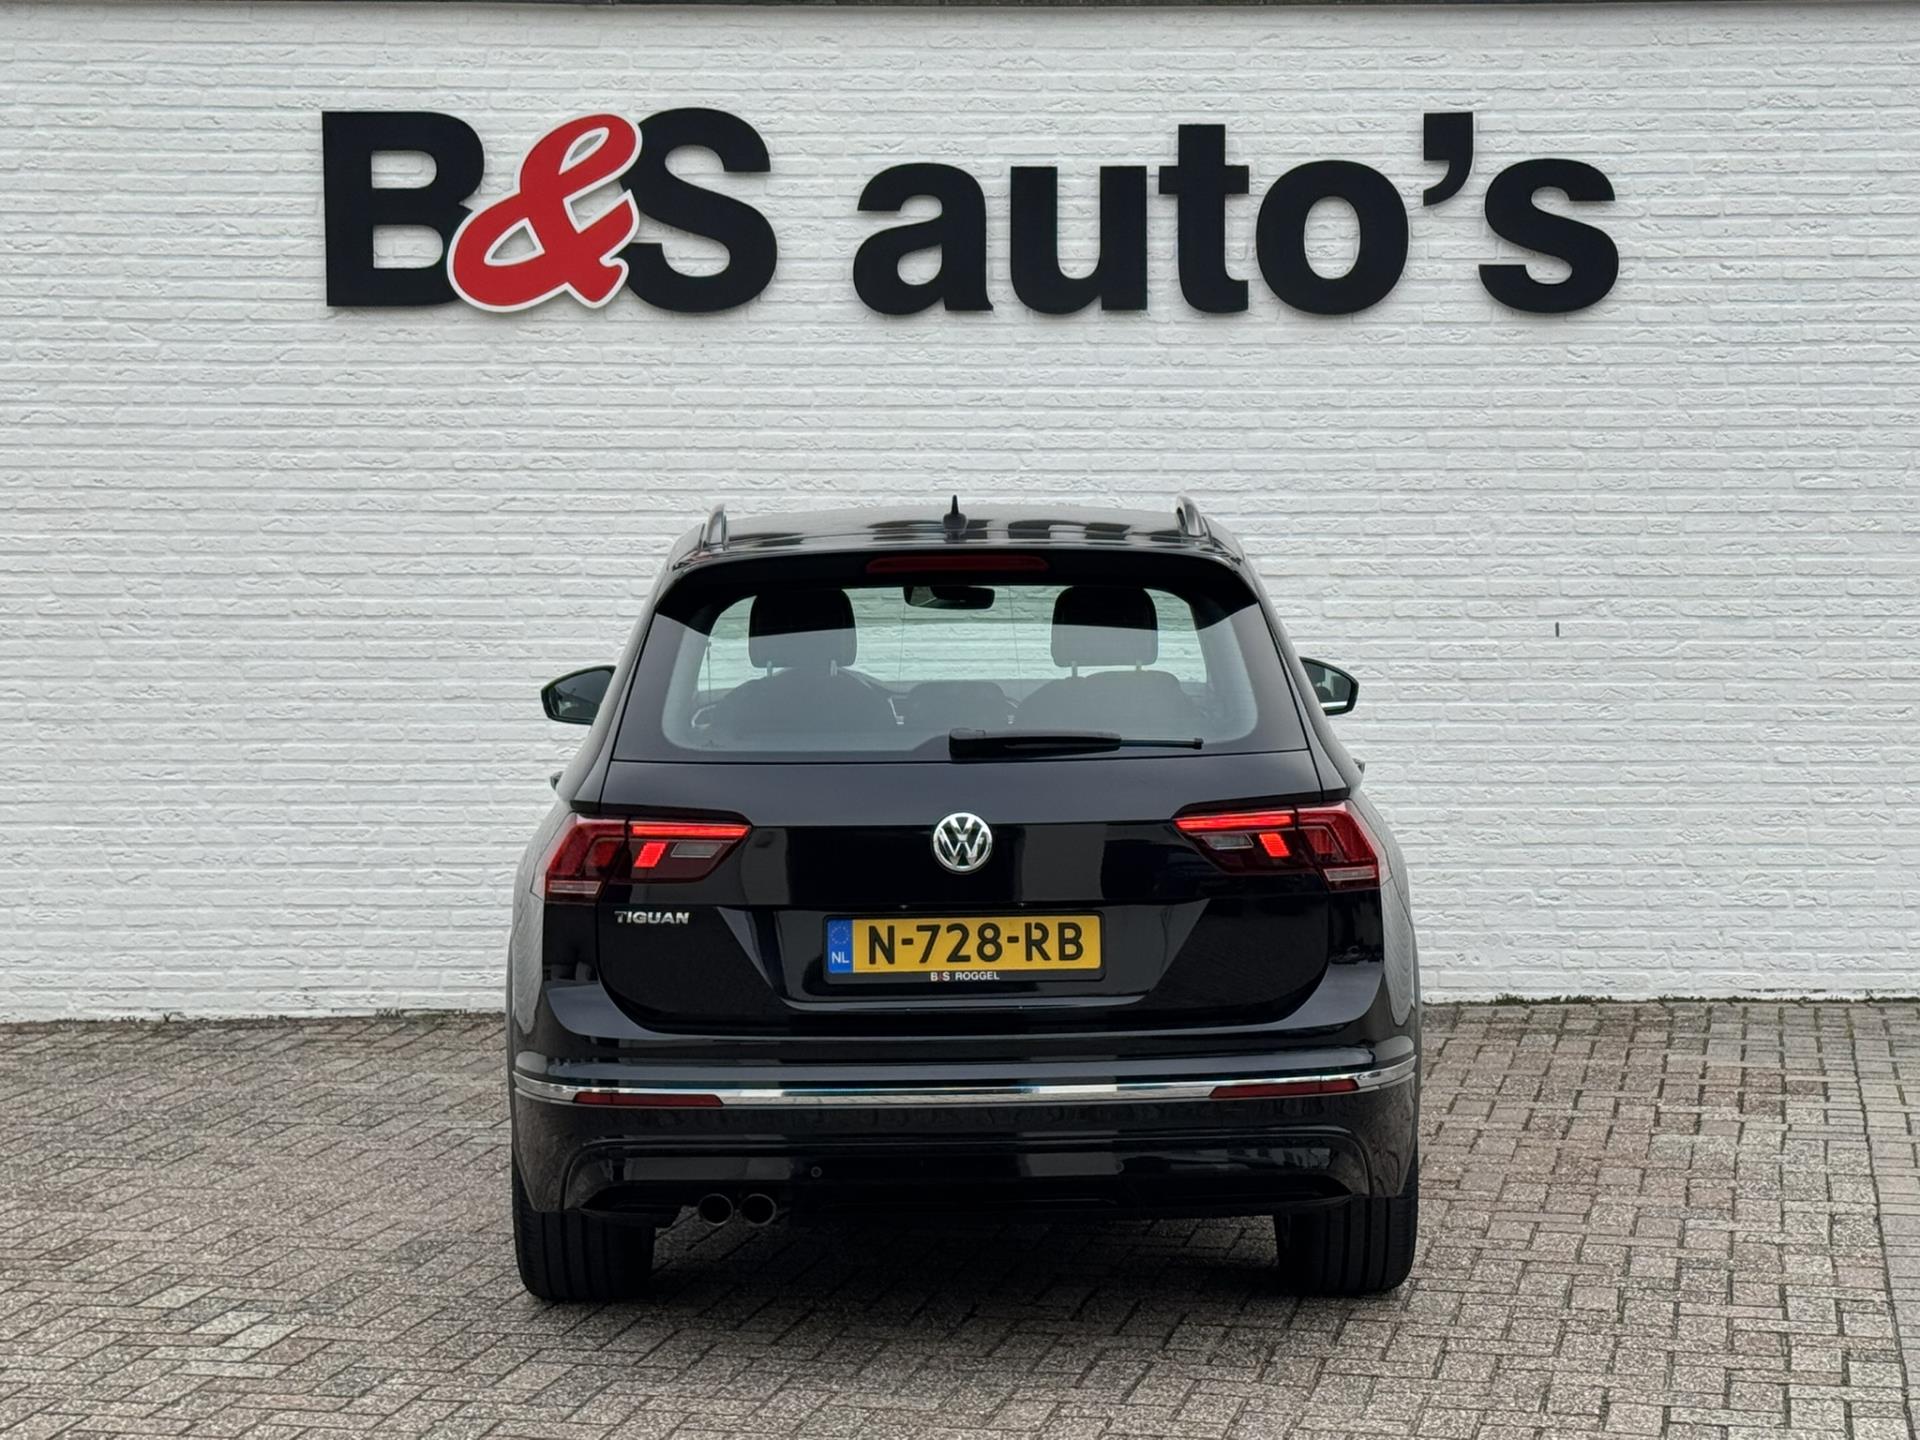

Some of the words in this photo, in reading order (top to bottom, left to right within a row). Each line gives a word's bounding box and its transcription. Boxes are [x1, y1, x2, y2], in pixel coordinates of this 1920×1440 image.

[322, 107, 778, 314] B&S
[852, 111, 1620, 315] auto's
[614, 911, 690, 925] TIGUAN
[868, 922, 1084, 965] N-728-RB
[831, 951, 850, 964] NL
[955, 971, 1000, 981] ROGGEL
